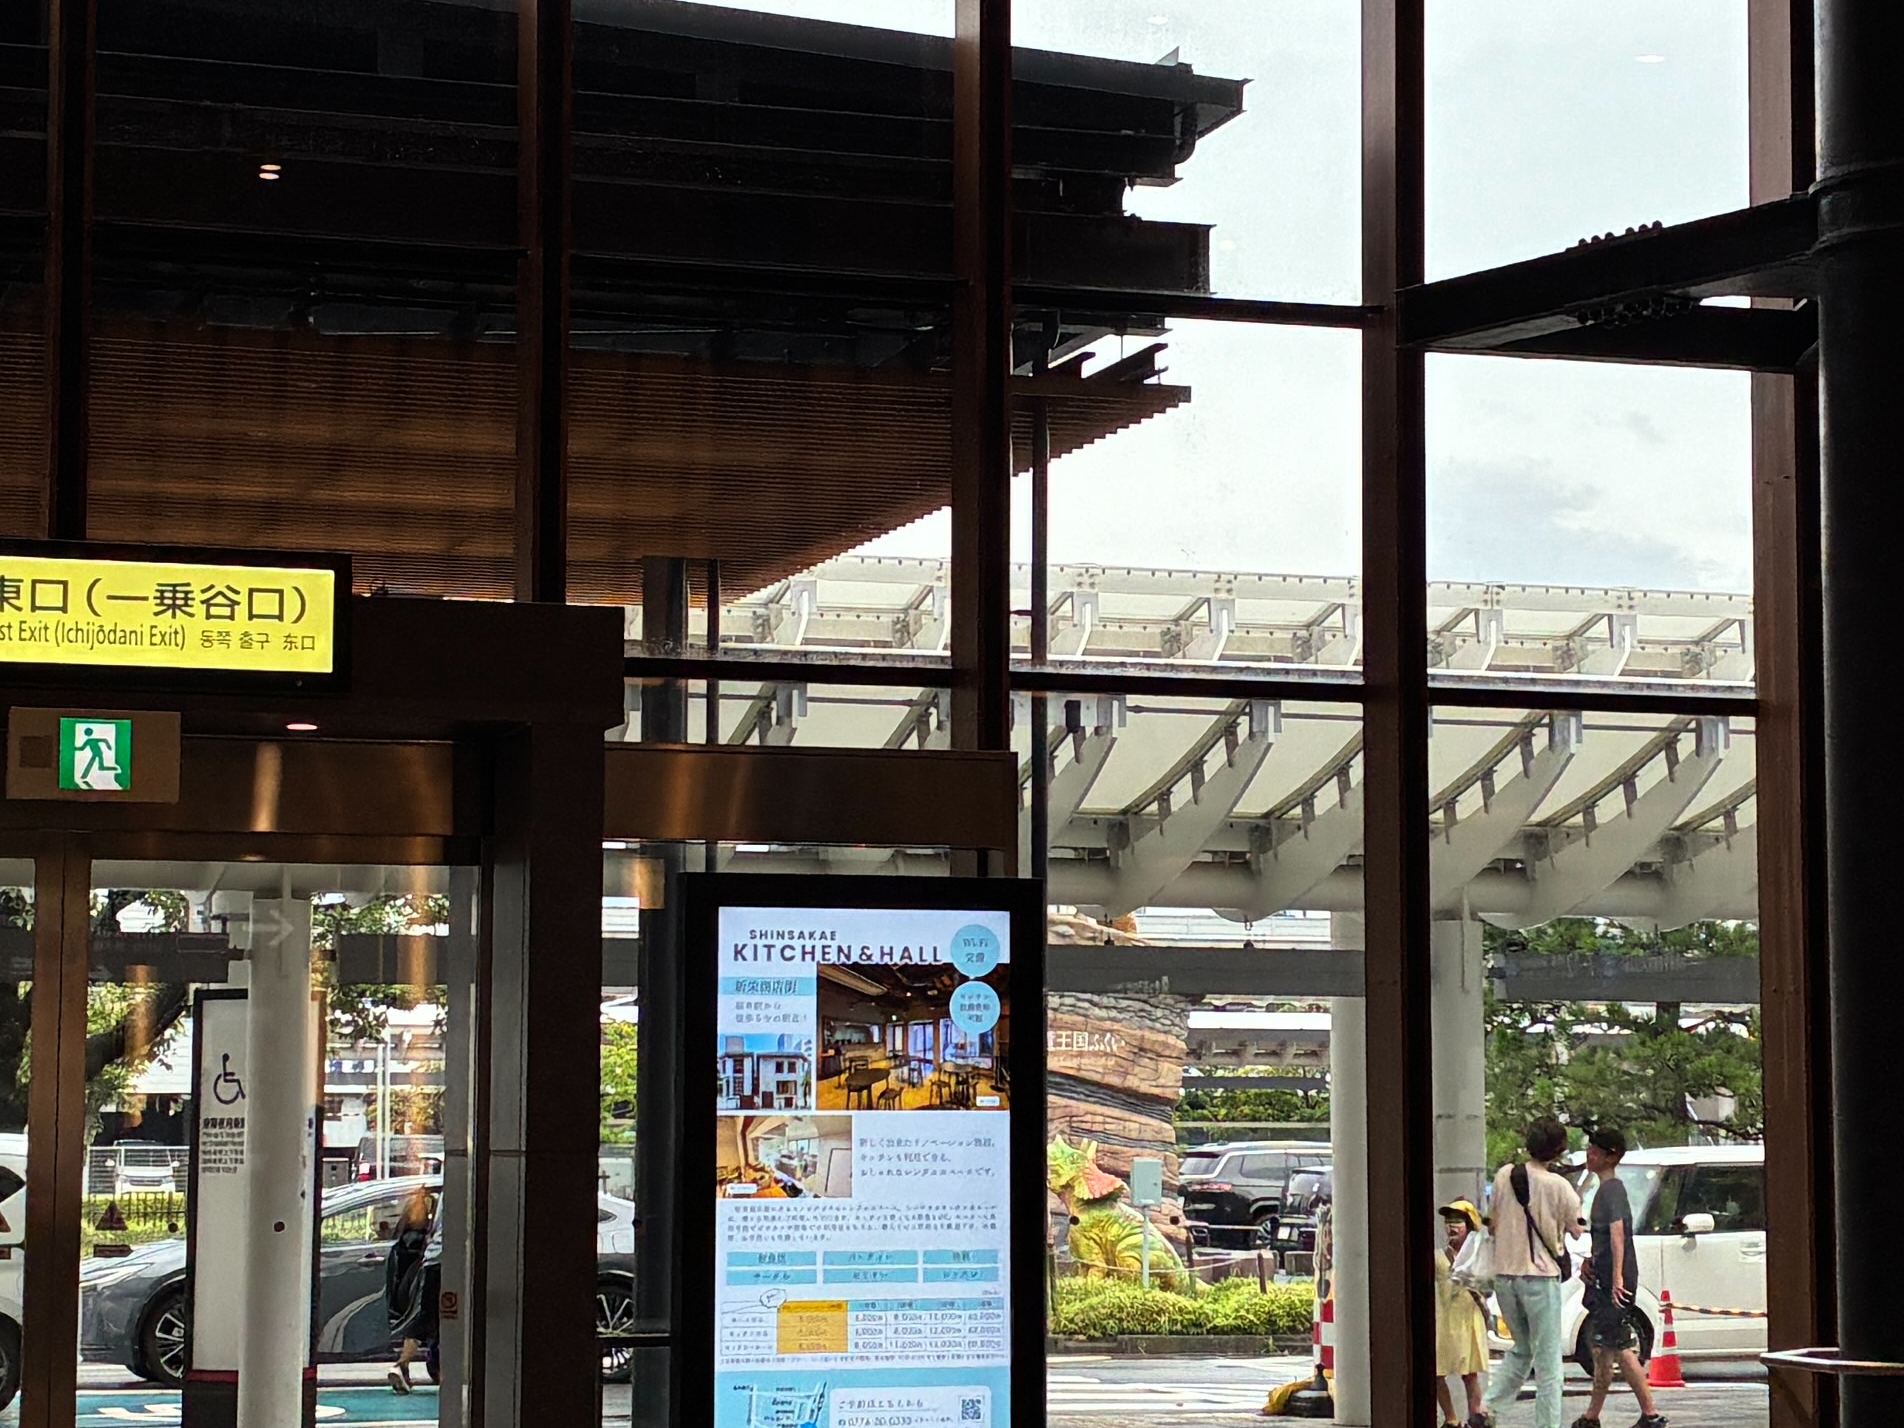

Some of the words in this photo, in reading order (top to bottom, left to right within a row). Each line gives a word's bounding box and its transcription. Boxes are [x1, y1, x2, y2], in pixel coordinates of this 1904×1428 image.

[18, 620, 50, 643] Exit
[54, 621, 144, 651] (Ichijōdani
[149, 624, 186, 651] Exit)
[282, 632, 316, 652] 东口
[748, 929, 837, 941] SHINSAKAE
[733, 943, 943, 963] KITCHEN&HALL
